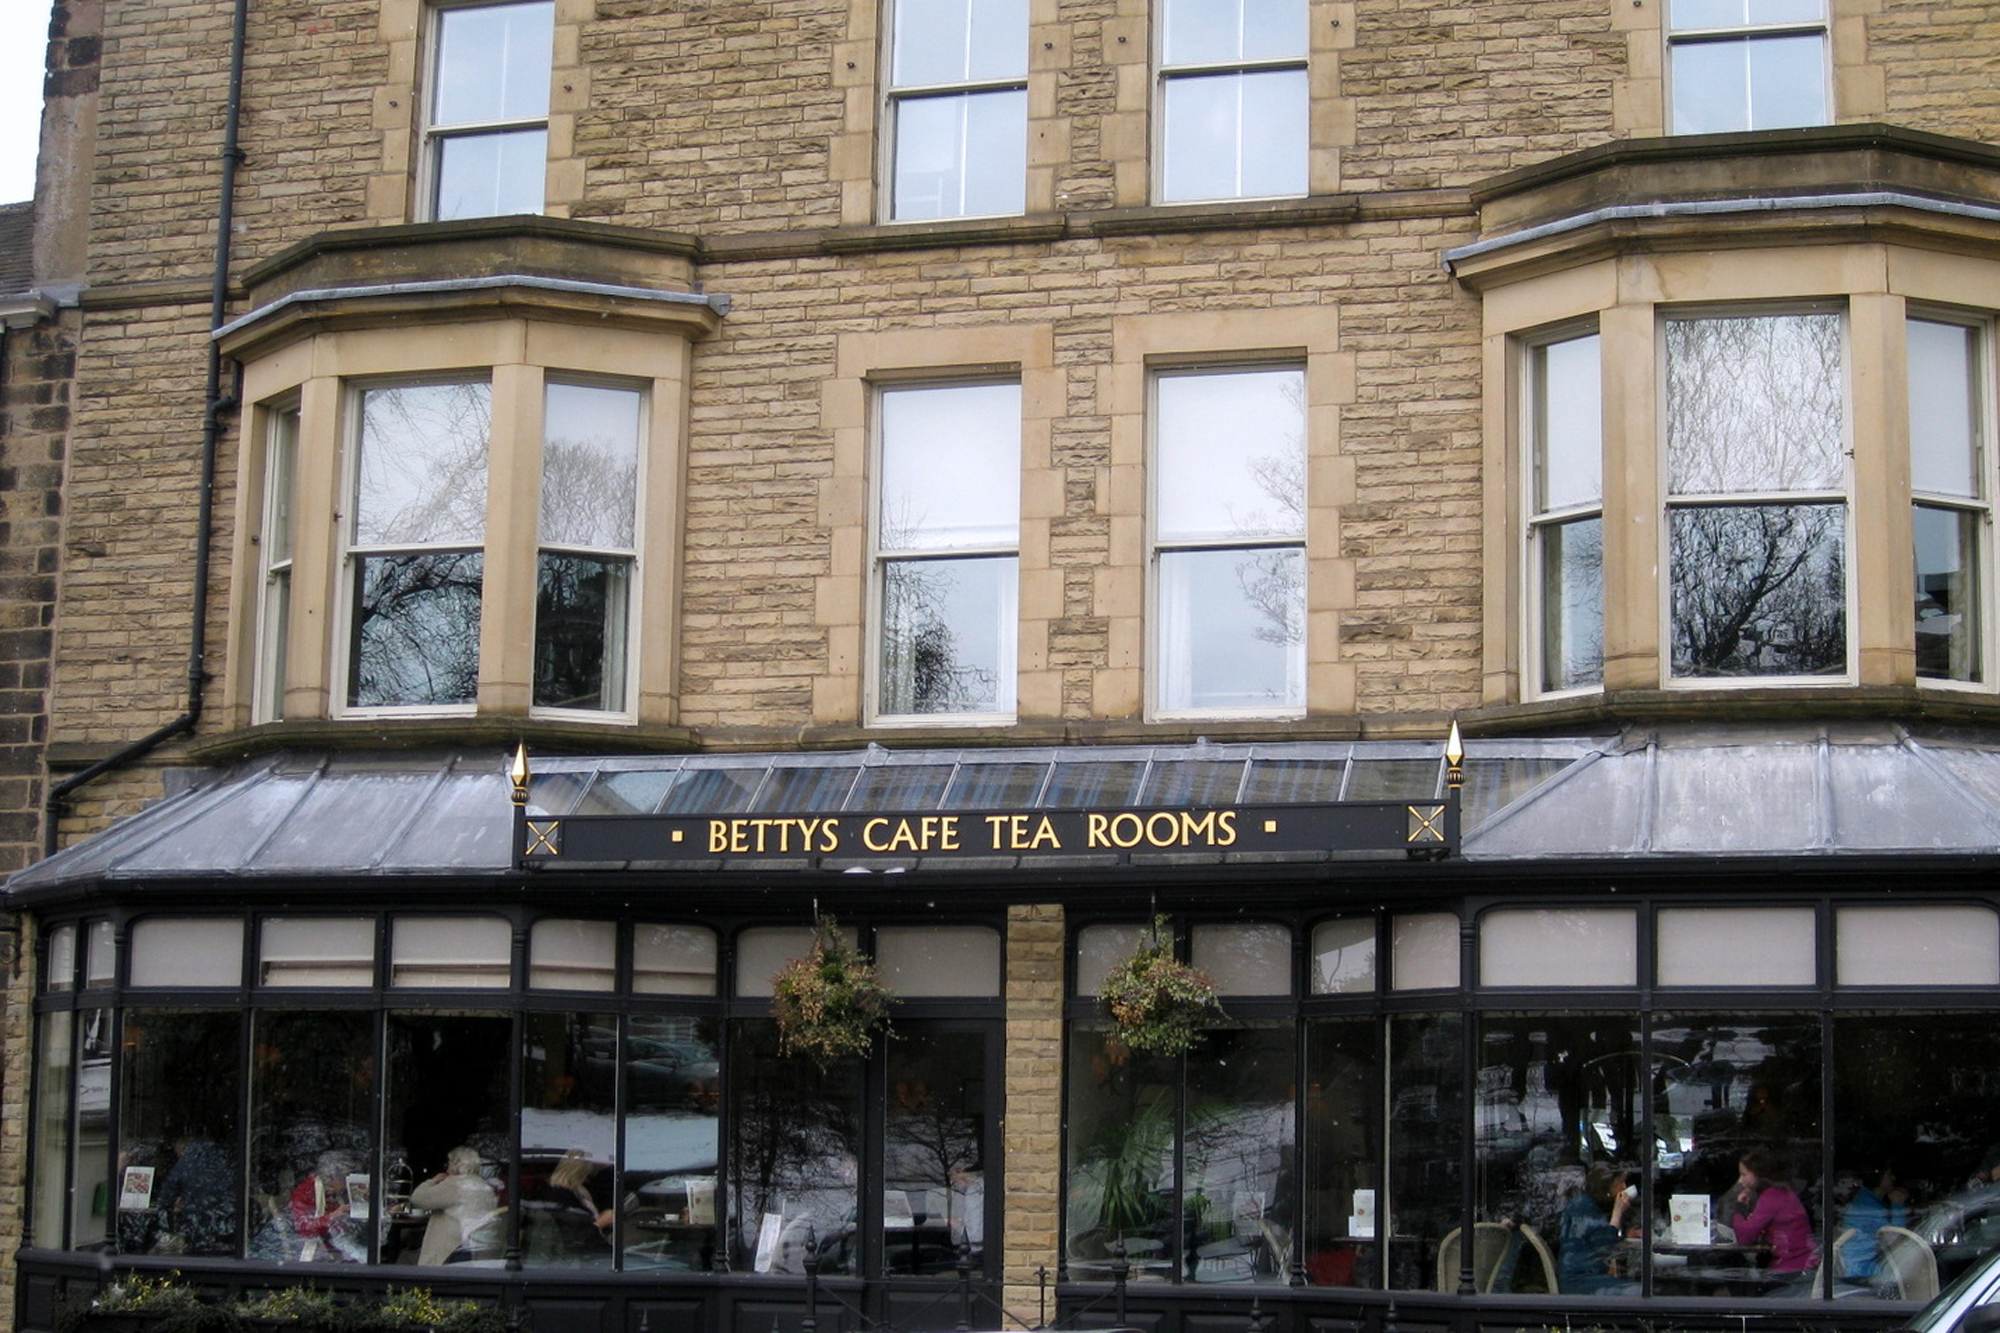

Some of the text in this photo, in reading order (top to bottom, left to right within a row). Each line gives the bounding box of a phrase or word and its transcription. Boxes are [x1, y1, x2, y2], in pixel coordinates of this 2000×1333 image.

[708, 811, 1236, 852] BETTYS CAFE TEA ROOMS
